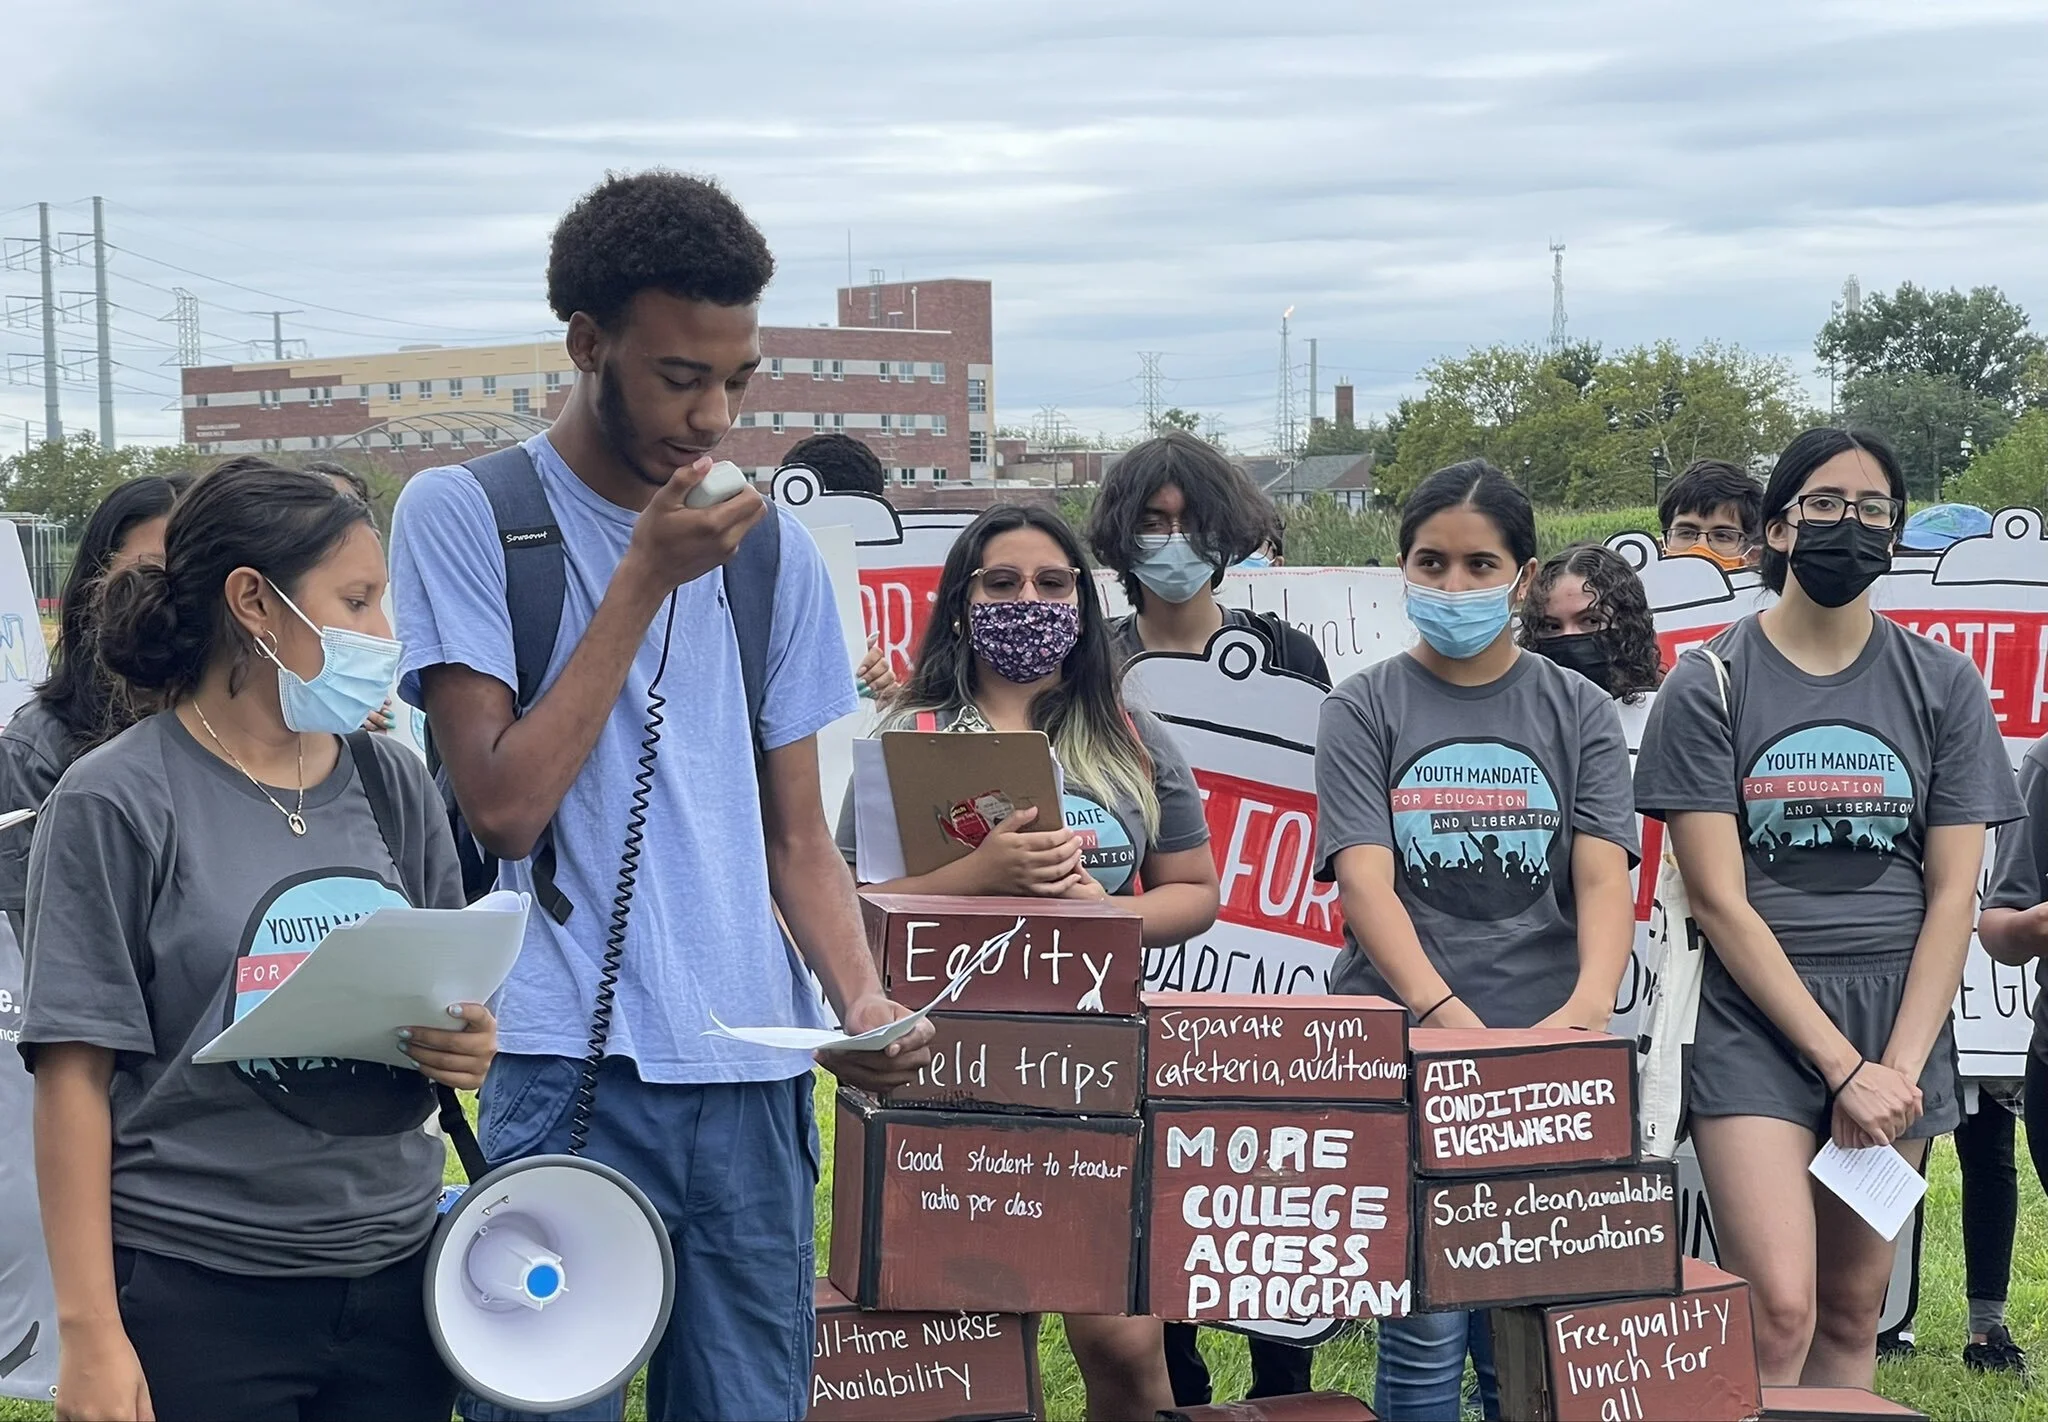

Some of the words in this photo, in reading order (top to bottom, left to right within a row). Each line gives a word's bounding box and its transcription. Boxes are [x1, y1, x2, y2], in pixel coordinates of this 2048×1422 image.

[1414, 765, 1463, 783] YOUTH
[1467, 766, 1539, 785] MANDATE
[1766, 752, 1816, 771] YOUTH
[1822, 752, 1896, 772] MANDATE
[1392, 793, 1421, 807] FOR
[1434, 793, 1526, 808] EDUCATION
[1745, 783, 1774, 795] FOR
[1787, 780, 1883, 794] EDUCATION
[1065, 808, 1105, 827] DATE
[1432, 817, 1460, 830] AND
[1471, 813, 1560, 828] LIBERATION
[1785, 805, 1813, 816] AND
[1825, 802, 1915, 814] LIBERATION
[1079, 849, 1135, 865] RATION
[265, 916, 330, 945] YOUTH
[239, 964, 280, 983] FOR
[906, 920, 1114, 1013] Equity
[1160, 1011, 1284, 1057] Separate
[1303, 1016, 1369, 1062] gym,
[1015, 1044, 1119, 1105] trips
[1423, 1058, 1481, 1093] AIR
[1425, 1078, 1616, 1124] CONDITIONER
[1166, 1125, 1354, 1174] MORE
[1433, 1111, 1594, 1159] EVERYWHERE
[897, 1139, 944, 1173] Good
[966, 1145, 1035, 1175] student
[1042, 1151, 1060, 1177] to
[1068, 1149, 1129, 1180] teacher
[921, 1184, 960, 1211] ratio
[967, 1193, 998, 1221] per
[1004, 1191, 1044, 1219] class
[1182, 1184, 1390, 1231] COLLEGE
[1183, 1230, 1371, 1278] ACCESS
[1187, 1273, 1412, 1320] PROGRAM
[813, 1319, 909, 1358] ull-time
[922, 1313, 1002, 1347] NURSE
[1620, 1298, 1730, 1358] quality
[812, 1360, 972, 1408] Availability
[1567, 1348, 1651, 1395] lunch
[1661, 1342, 1712, 1381] for
[1601, 1385, 1644, 1422] all
